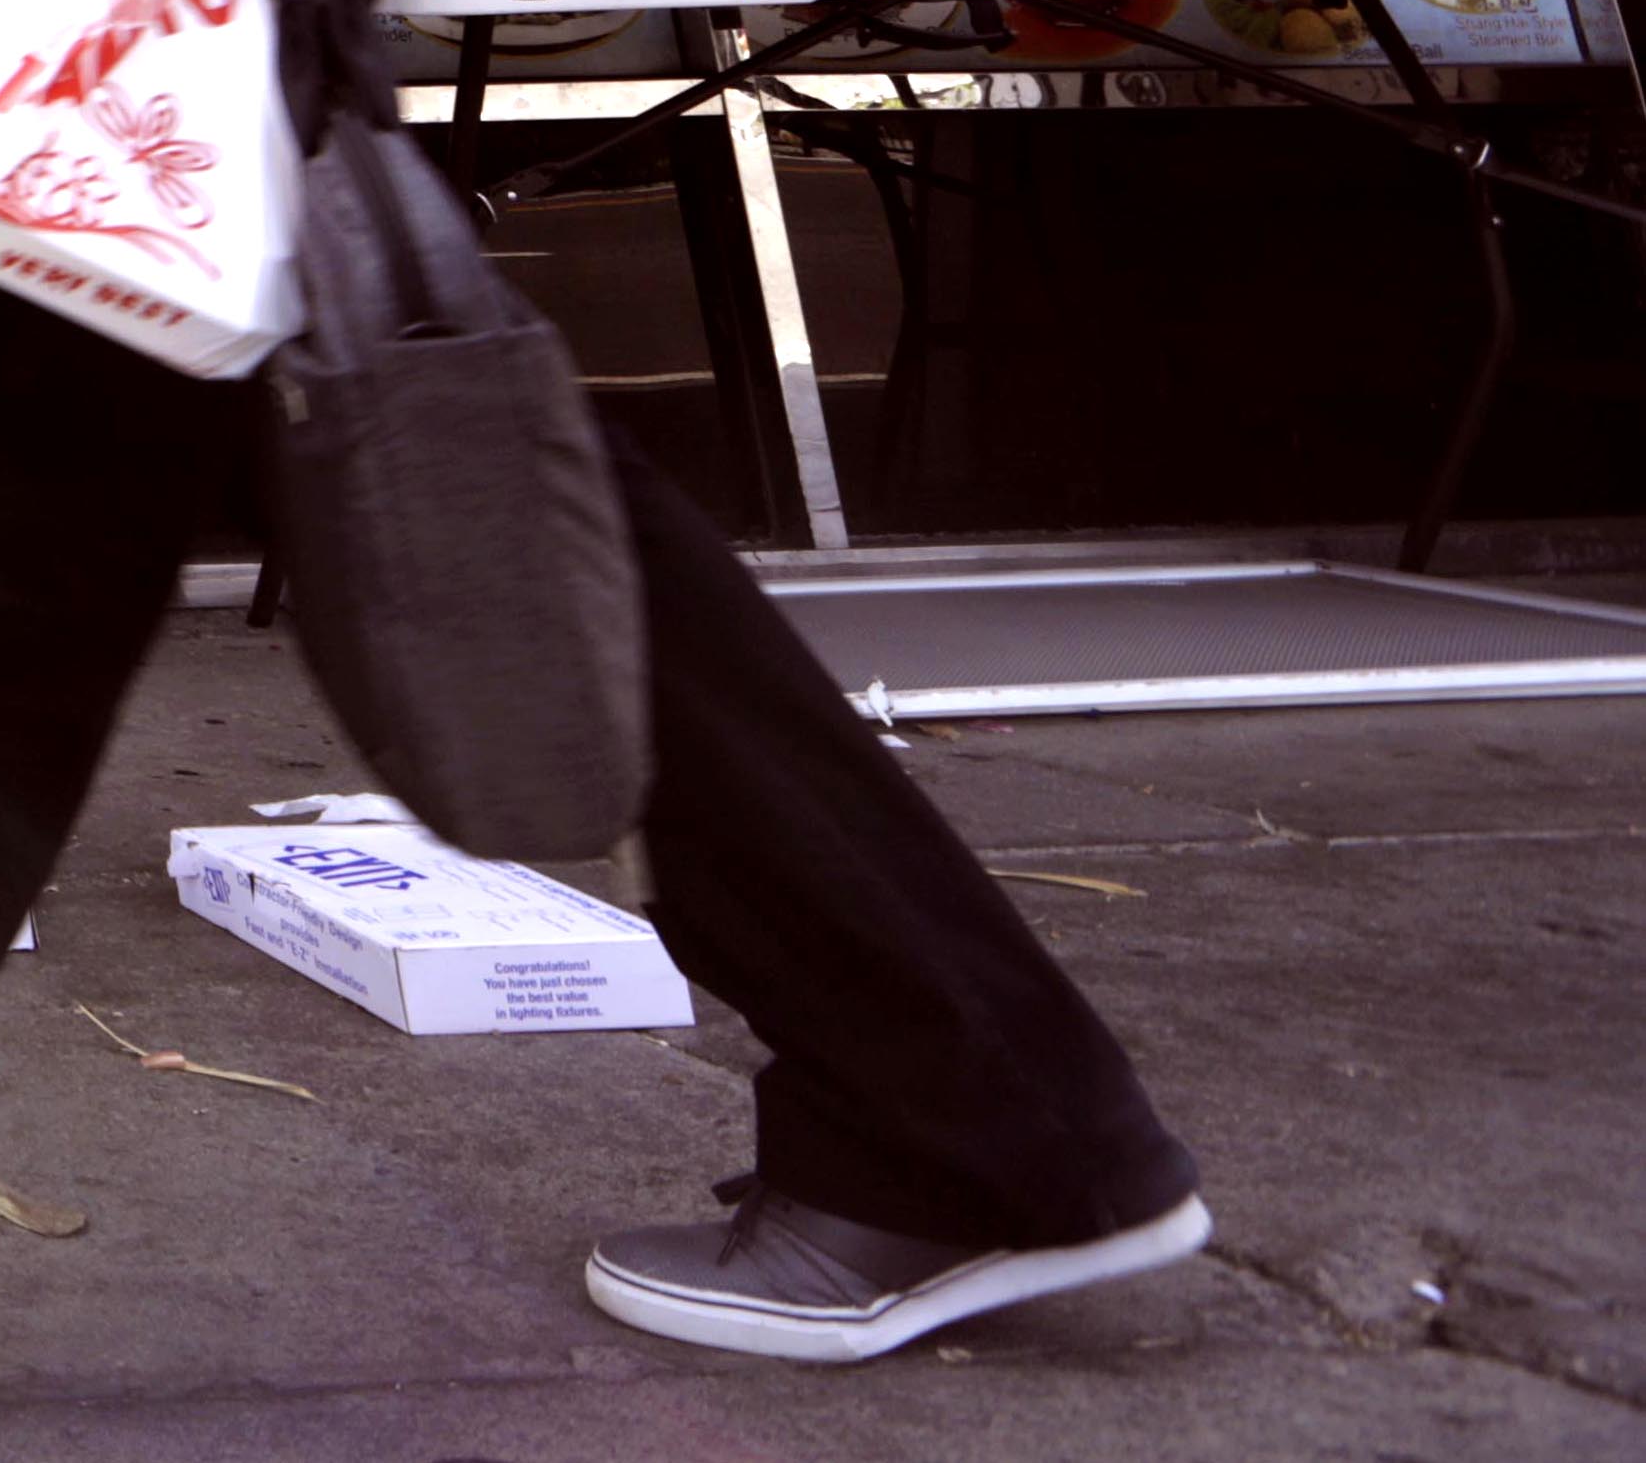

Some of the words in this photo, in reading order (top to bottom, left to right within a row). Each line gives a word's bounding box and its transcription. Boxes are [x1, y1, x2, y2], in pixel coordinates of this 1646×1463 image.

[1468, 35, 1532, 48] Steamed
[1412, 44, 1443, 60] Ball
[0, 250, 86, 294] VERY
[94, 277, 191, 326] BEST
[272, 847, 429, 888] EXIT
[267, 930, 284, 948] and
[494, 959, 591, 975] Congratulations!
[484, 978, 506, 989] You
[508, 977, 537, 988] have
[539, 976, 561, 990] just
[564, 975, 607, 987] chosen
[506, 992, 526, 1003] the
[528, 992, 554, 1003] best
[556, 991, 589, 1002] value
[495, 1007, 507, 1019] in
[509, 1006, 553, 1021] lighting
[555, 1005, 604, 1018] fixtures.
